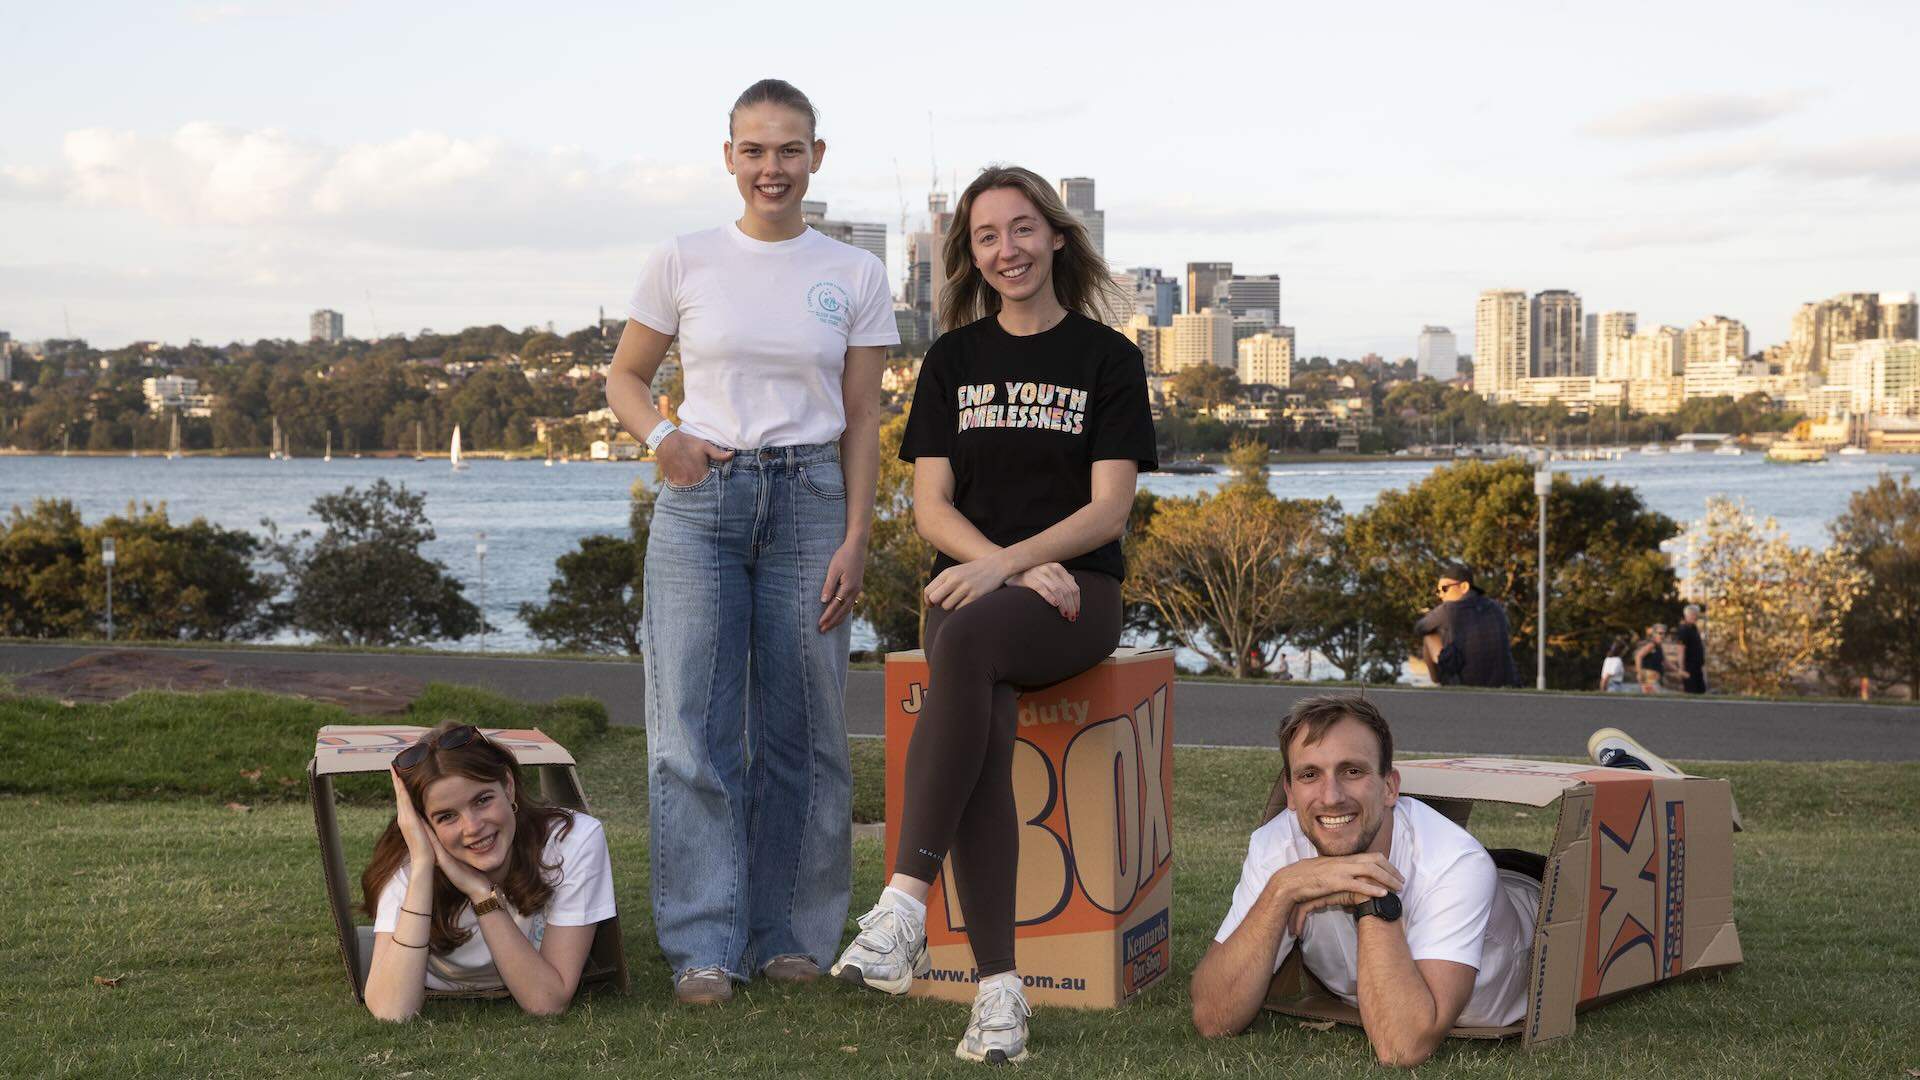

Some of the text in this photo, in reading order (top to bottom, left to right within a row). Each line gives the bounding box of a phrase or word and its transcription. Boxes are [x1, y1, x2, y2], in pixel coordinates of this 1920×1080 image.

[957, 381, 1088, 412] END YOUTH
[1018, 699, 1090, 727] duty
[1127, 918, 1167, 961] Kennards
[1532, 944, 1548, 1037] Contents
